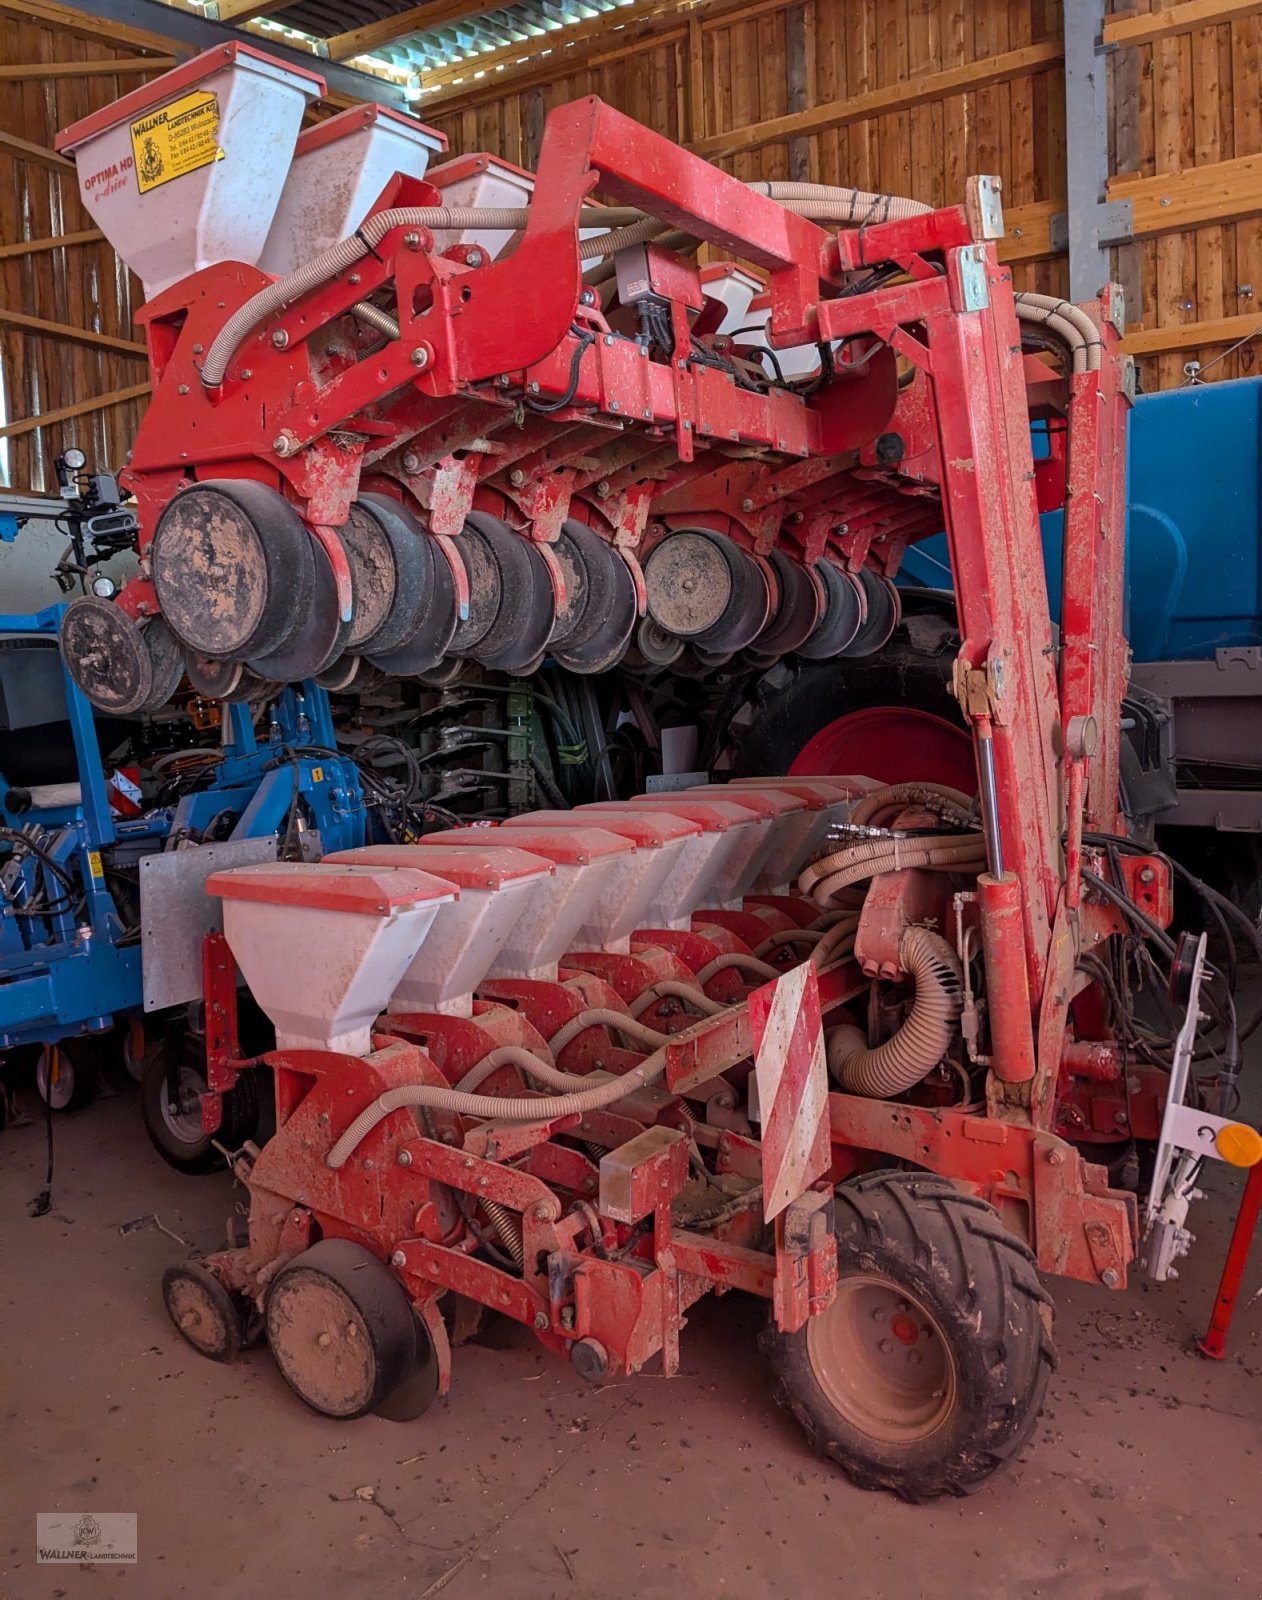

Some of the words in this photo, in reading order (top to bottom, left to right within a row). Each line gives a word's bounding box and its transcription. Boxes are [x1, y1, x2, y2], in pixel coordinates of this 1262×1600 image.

[132, 112, 169, 139] WALLNER
[167, 106, 205, 131] LANDTECHNIK
[85, 164, 119, 190] OPTIMA
[120, 156, 133, 172] HD
